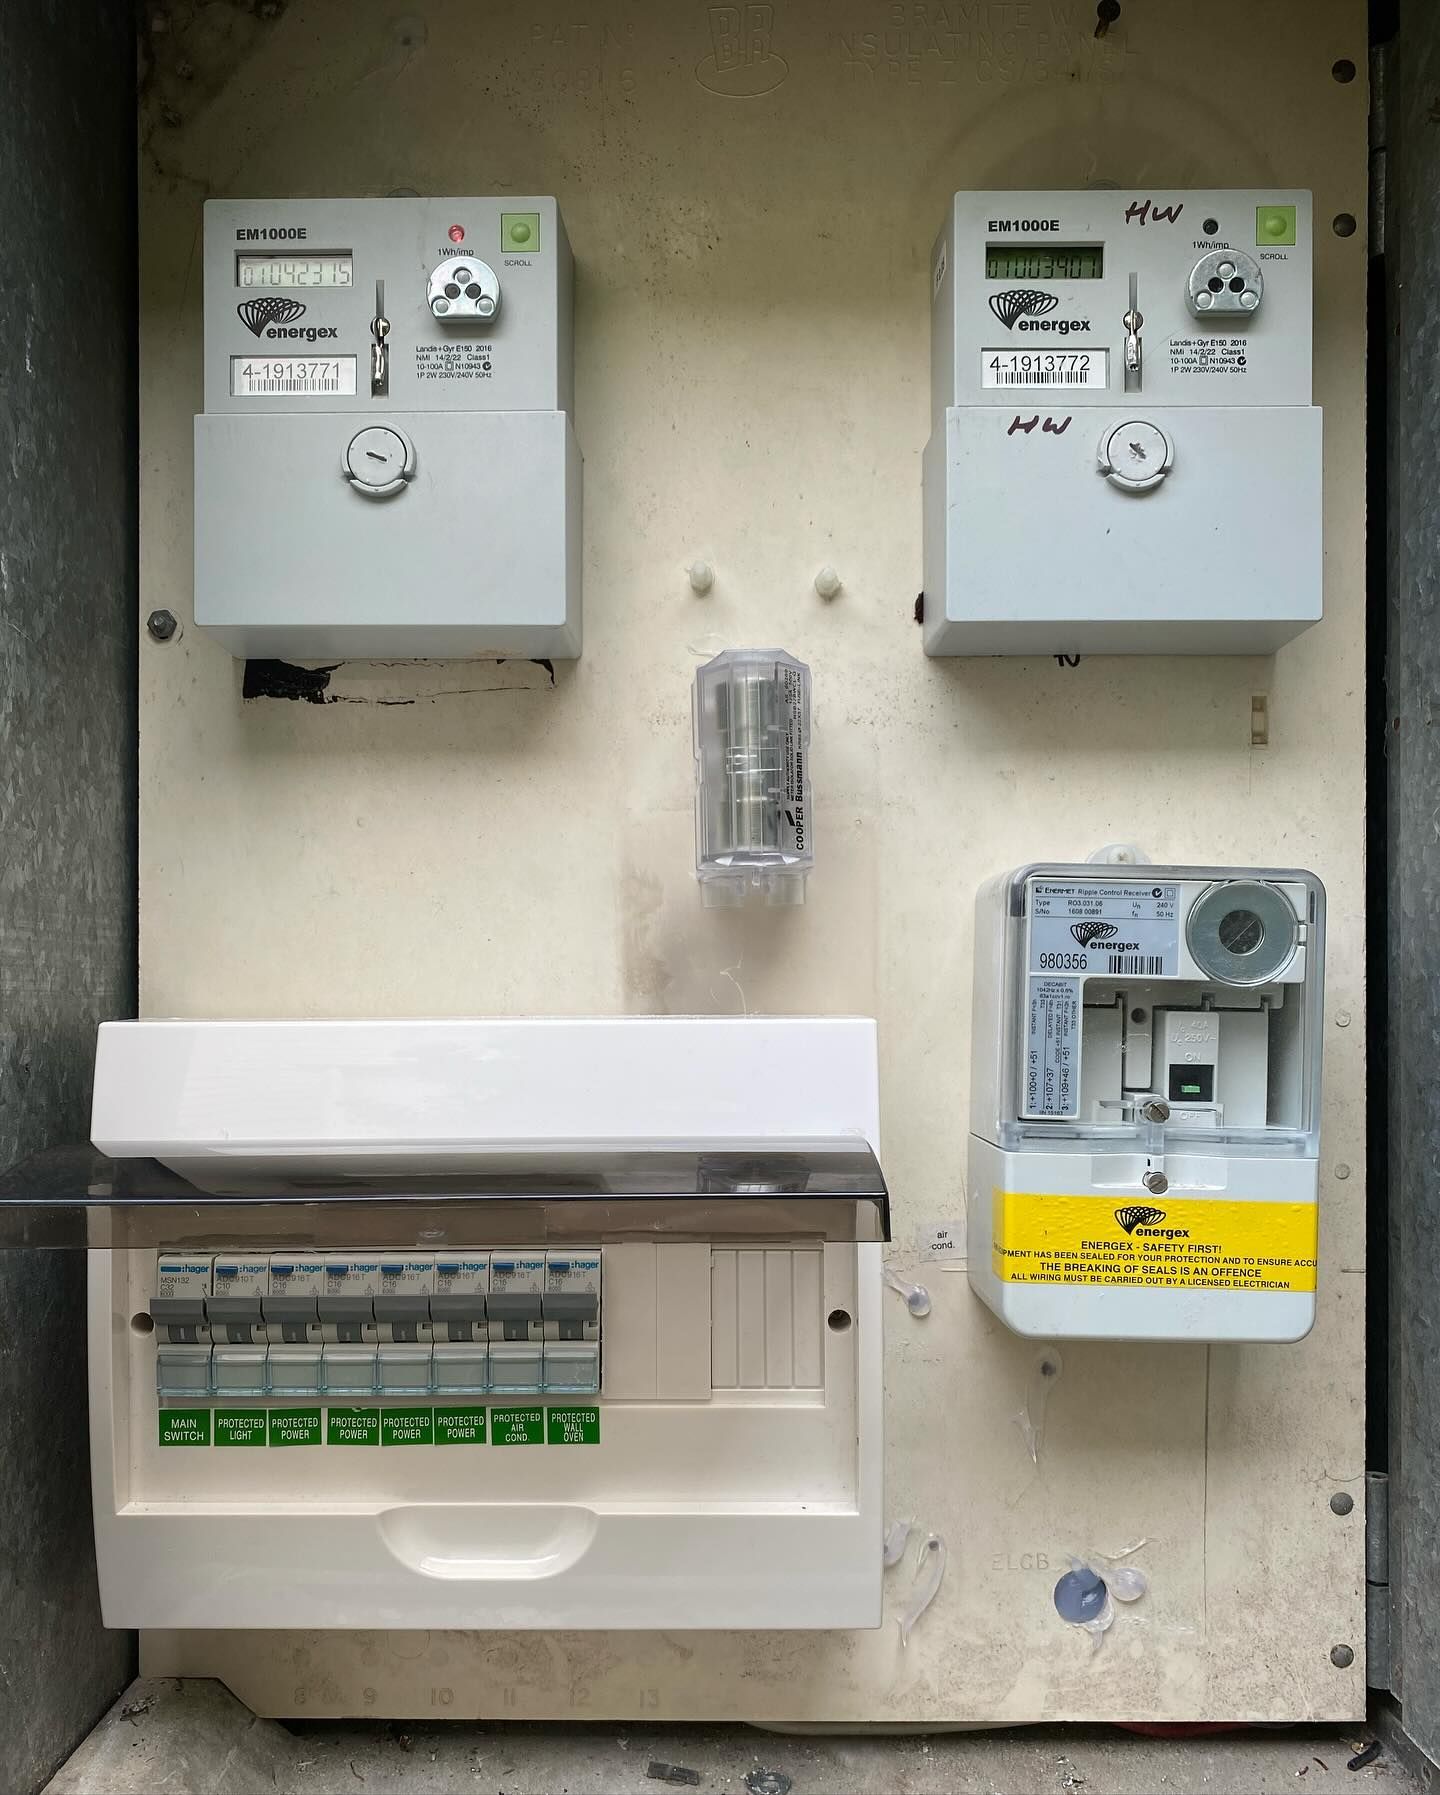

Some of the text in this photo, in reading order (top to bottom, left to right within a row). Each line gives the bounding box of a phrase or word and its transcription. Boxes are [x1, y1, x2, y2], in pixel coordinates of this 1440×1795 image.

[1125, 199, 1184, 226] HW
[988, 220, 1060, 232] EM1000E
[236, 228, 307, 240] EM1000E
[1192, 241, 1230, 250] 1Wh/imp
[1018, 320, 1092, 335] energex
[266, 327, 339, 342] energex
[990, 355, 1091, 371] 4-1913772
[242, 362, 340, 379] 4-1913771
[1008, 415, 1072, 435] HW
[795, 752, 804, 802] Bussmann
[796, 807, 804, 851] COOPER
[1090, 941, 1140, 952] energex
[1040, 953, 1088, 969] 980356
[1029, 1051, 1037, 1064] +51
[1062, 1047, 1070, 1060] +51
[1029, 1072, 1037, 1101] +100+0
[1136, 1227, 1190, 1239] energex
[931, 1241, 956, 1250] cond.
[1081, 1241, 1133, 1250] ENERGEX
[1143, 1243, 1185, 1252] SAFETY
[1188, 1244, 1222, 1253] FIRST!
[1033, 1251, 1051, 1259] HAS
[1117, 1253, 1135, 1261] FOR
[1137, 1254, 1162, 1262] YOUR
[1165, 1255, 1220, 1264] PROTECTION
[1222, 1257, 1240, 1265] AND
[1258, 1258, 1292, 1266] ENSURE
[1040, 1262, 1262, 1277] THE BREAKING OF SEALS IS AN OFFENCE
[1063, 1274, 1087, 1282] MUST
[1104, 1276, 1143, 1284] CARRIED
[1188, 1279, 1231, 1287] LICENSED
[1233, 1280, 1290, 1288] ELECTRICIAN
[218, 1418, 265, 1429] PROTECTED
[271, 1417, 319, 1428] PROTECTED
[330, 1417, 378, 1428] PROTECTED
[383, 1417, 430, 1428] PROTECTED
[437, 1416, 485, 1427] PROTECTED
[493, 1413, 541, 1422] PROTECTED
[551, 1412, 596, 1423] PROTECTED
[171, 1419, 197, 1429] MAIN
[510, 1423, 524, 1432] AIR
[563, 1423, 584, 1432] WALL
[164, 1431, 204, 1441] SWITCH
[229, 1430, 252, 1440] LIGHT
[281, 1429, 310, 1440] POWER
[339, 1429, 368, 1440] POWER
[392, 1429, 422, 1439] POWER
[447, 1428, 476, 1438] POWER
[505, 1433, 528, 1442] COND
[563, 1433, 584, 1442] OVEN
[362, 1688, 378, 1705] 9
[430, 1688, 455, 1706] 10
[503, 1688, 517, 1706] 11
[568, 1688, 591, 1707] 12
[638, 1689, 660, 1709] 13
